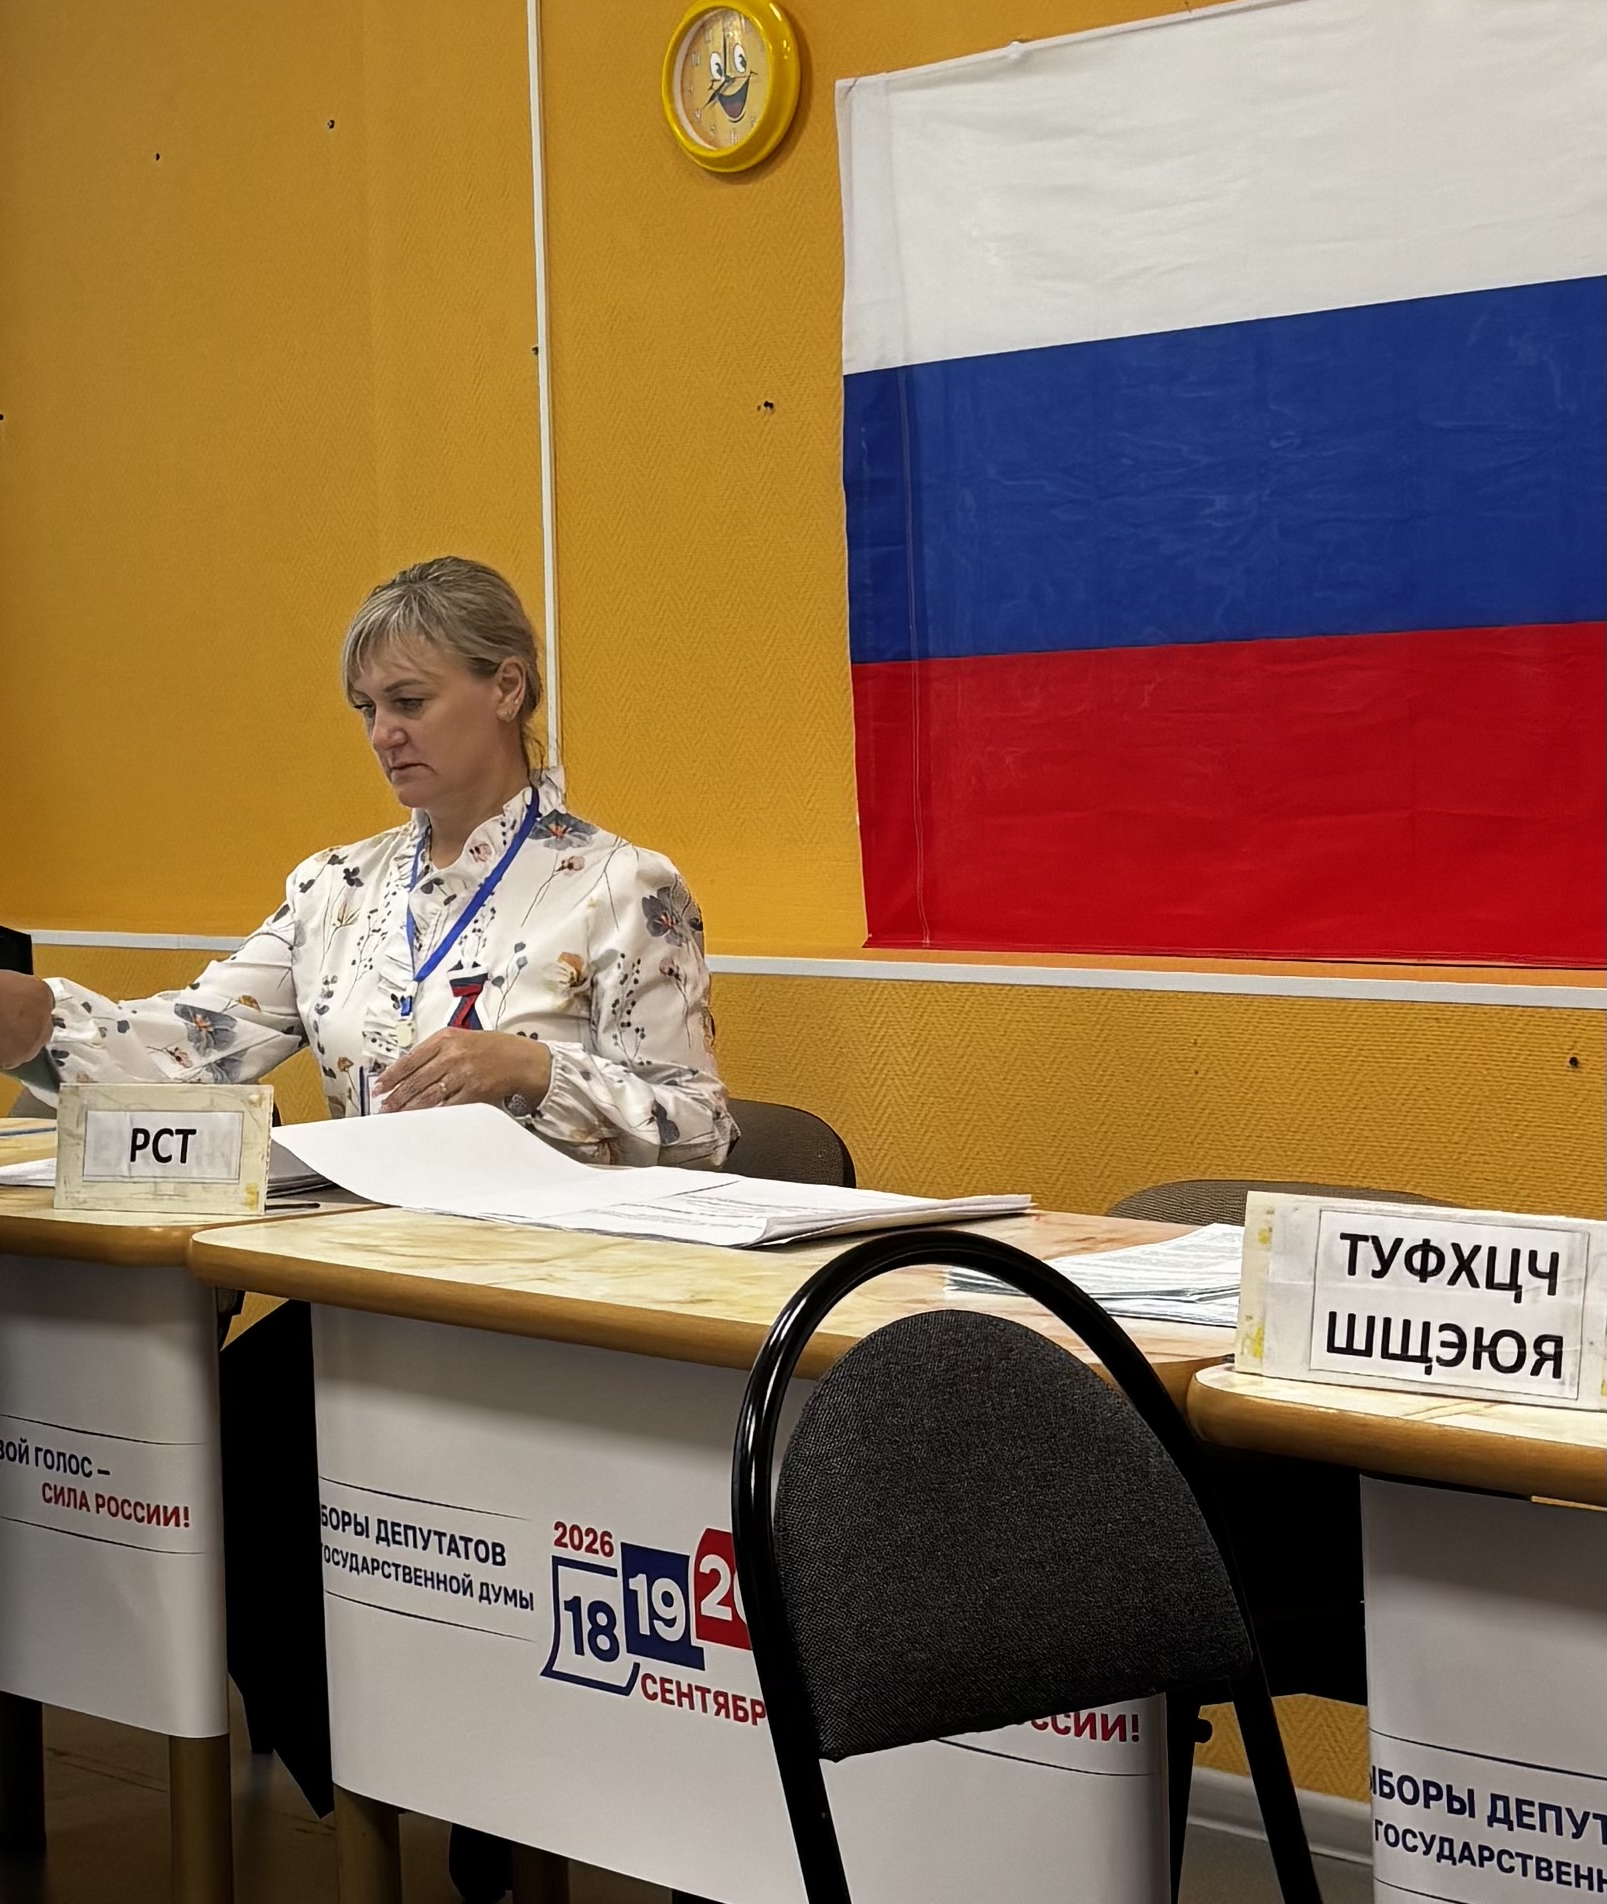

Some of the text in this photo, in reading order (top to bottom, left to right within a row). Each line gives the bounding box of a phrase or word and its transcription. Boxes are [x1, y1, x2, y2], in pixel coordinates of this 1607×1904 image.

[129, 1127, 196, 1165] РСТ
[1339, 1232, 1560, 1303] ТУФХЦЧ
[1326, 1311, 1564, 1379] ШЩЭЮЯ
[34, 1446, 93, 1478] ГОЛОС
[41, 1482, 190, 1528] СИЛА РОССИИ!
[321, 1504, 507, 1567] БОРЫ ДЕПУТАТОВ
[553, 1521, 614, 1558] 2026
[322, 1543, 535, 1611] ОСУДАРСТВЕННОЙ ДУМЫ
[563, 1596, 620, 1662] 18
[628, 1573, 687, 1642] 19
[640, 1673, 766, 1726] СЕНТЯБР
[1028, 1711, 1140, 1742] СИИ!
[1371, 1765, 1607, 1846] БОРЫ ДЕПУТ
[1374, 1819, 1607, 1893] ГОСУДАРСТВЕНН
